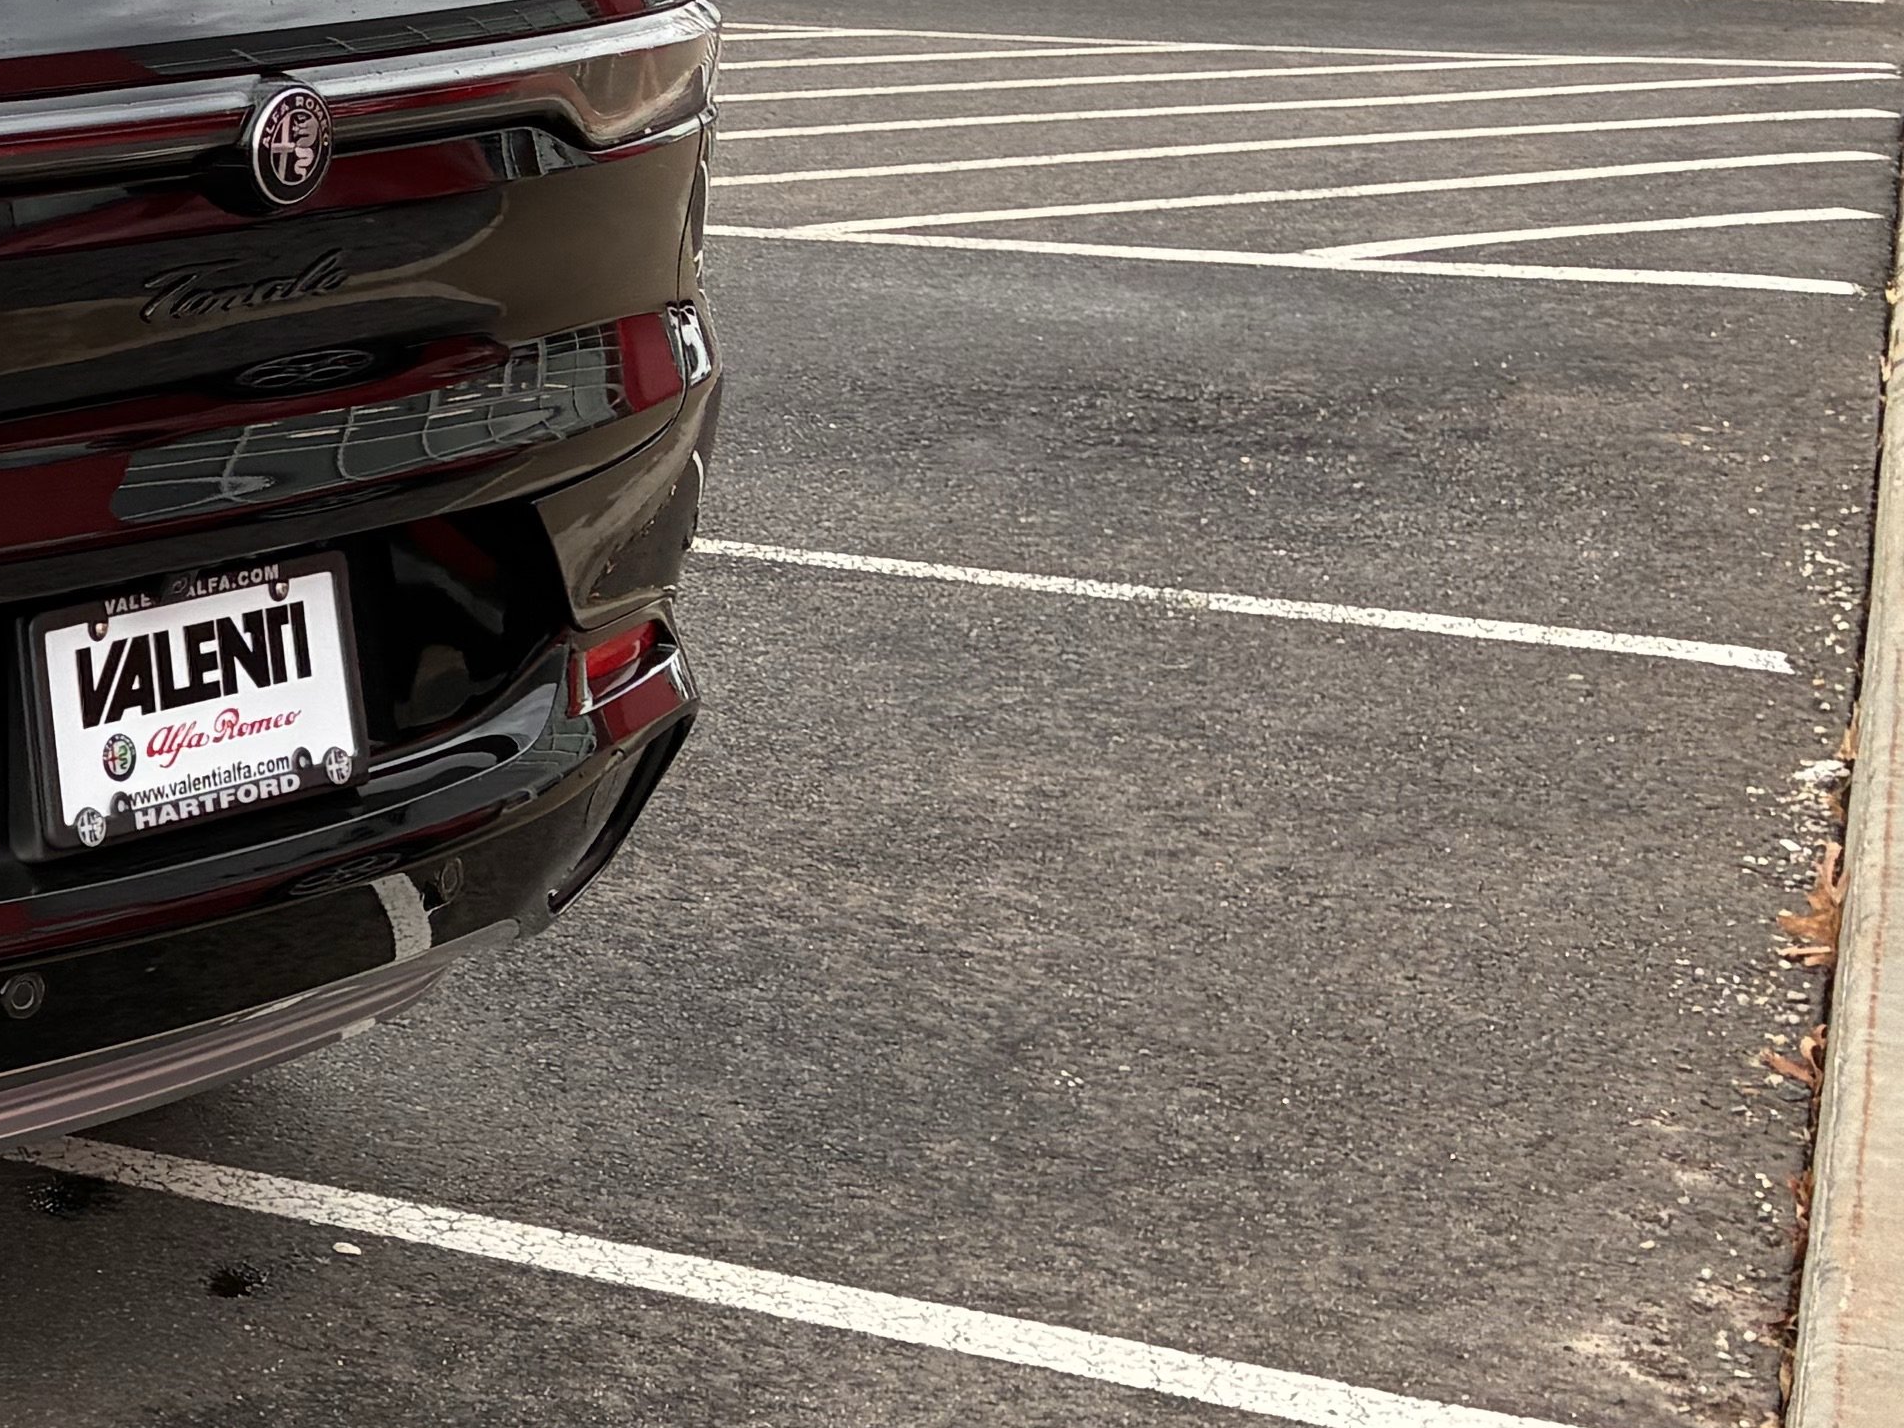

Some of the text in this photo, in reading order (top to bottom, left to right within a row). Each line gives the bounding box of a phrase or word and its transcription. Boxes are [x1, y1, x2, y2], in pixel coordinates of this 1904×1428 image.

[262, 102, 290, 149] ALFA
[104, 563, 280, 616] VALEALFA.COM
[75, 600, 312, 730] VALENTI
[146, 720, 210, 769] Alfa
[212, 707, 302, 744] Romeo
[128, 755, 291, 806] www.valentialfa.com
[134, 773, 301, 831] HARTFORD
